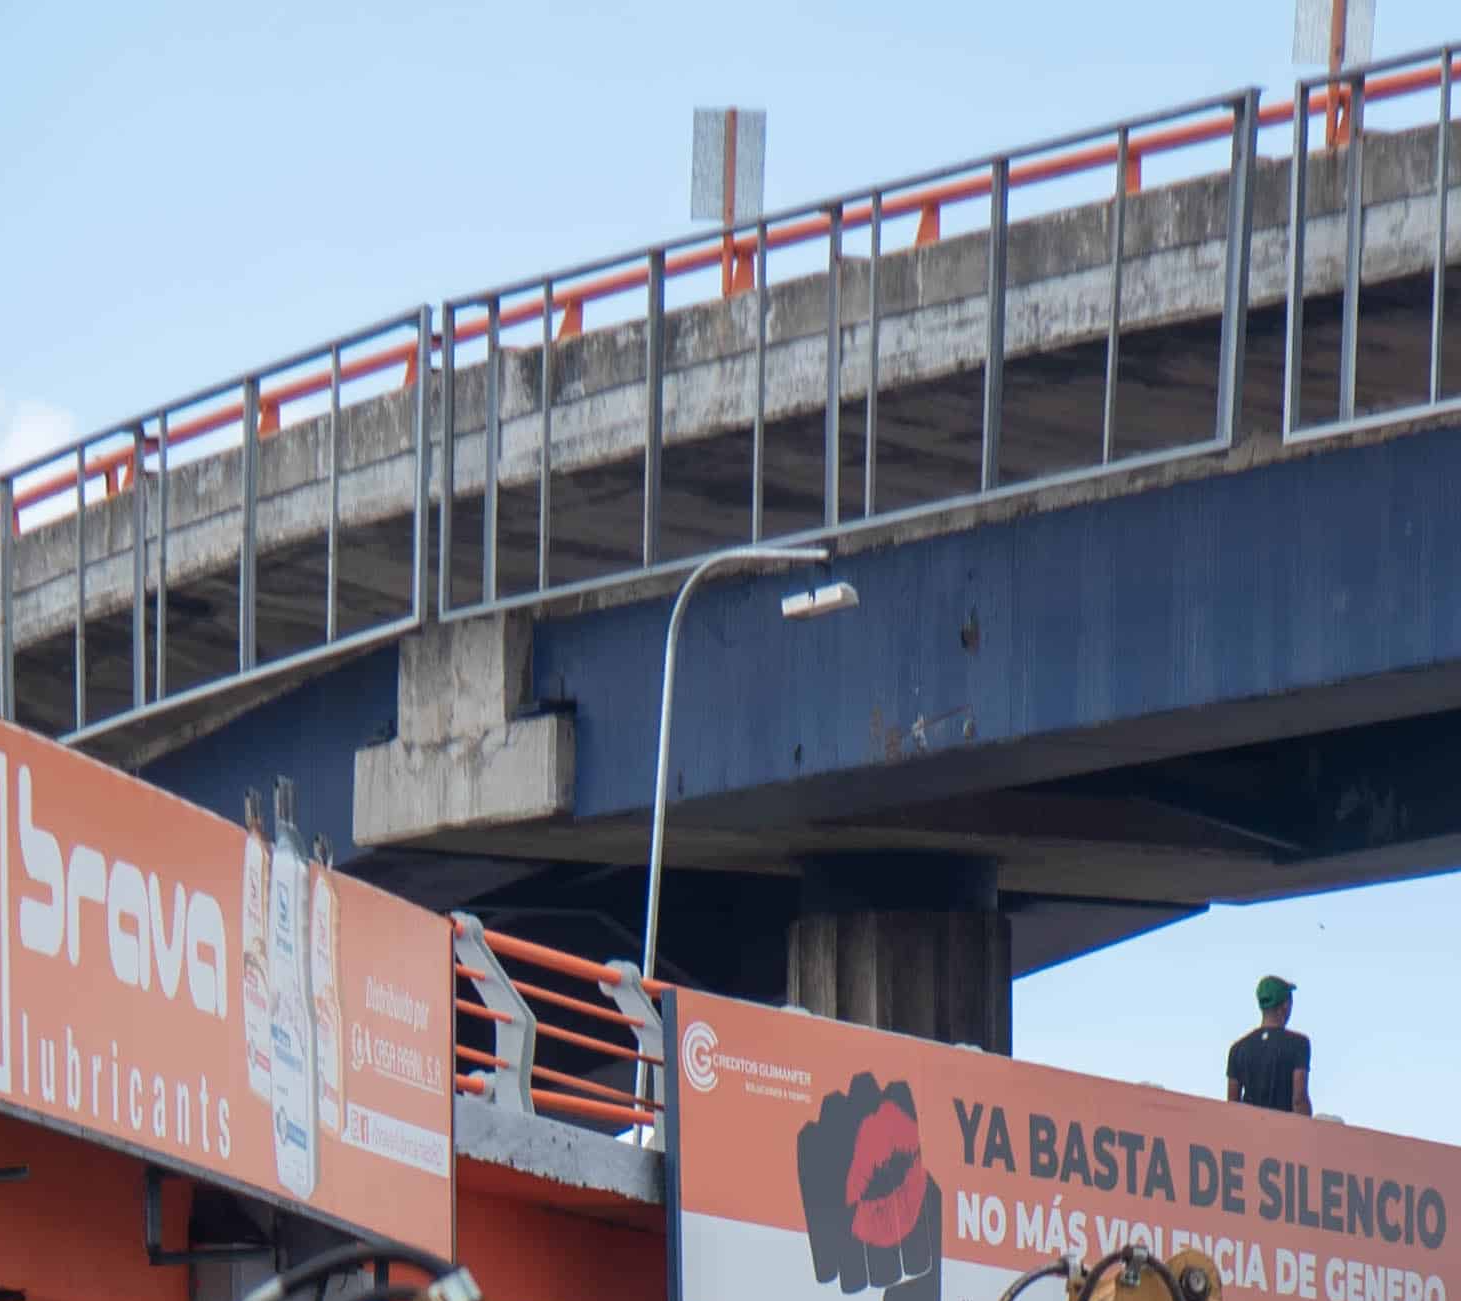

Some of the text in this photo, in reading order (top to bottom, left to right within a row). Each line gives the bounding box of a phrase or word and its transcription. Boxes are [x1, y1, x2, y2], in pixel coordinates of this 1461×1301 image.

[18, 764, 227, 1020] brava
[22, 1008, 231, 1160] lubricants
[953, 1097, 1447, 1250] YA BASTA DE SILENCIO
[957, 1191, 1007, 1246] NO
[1016, 1194, 1088, 1265] MÁS
[1276, 1248, 1317, 1300] DE
